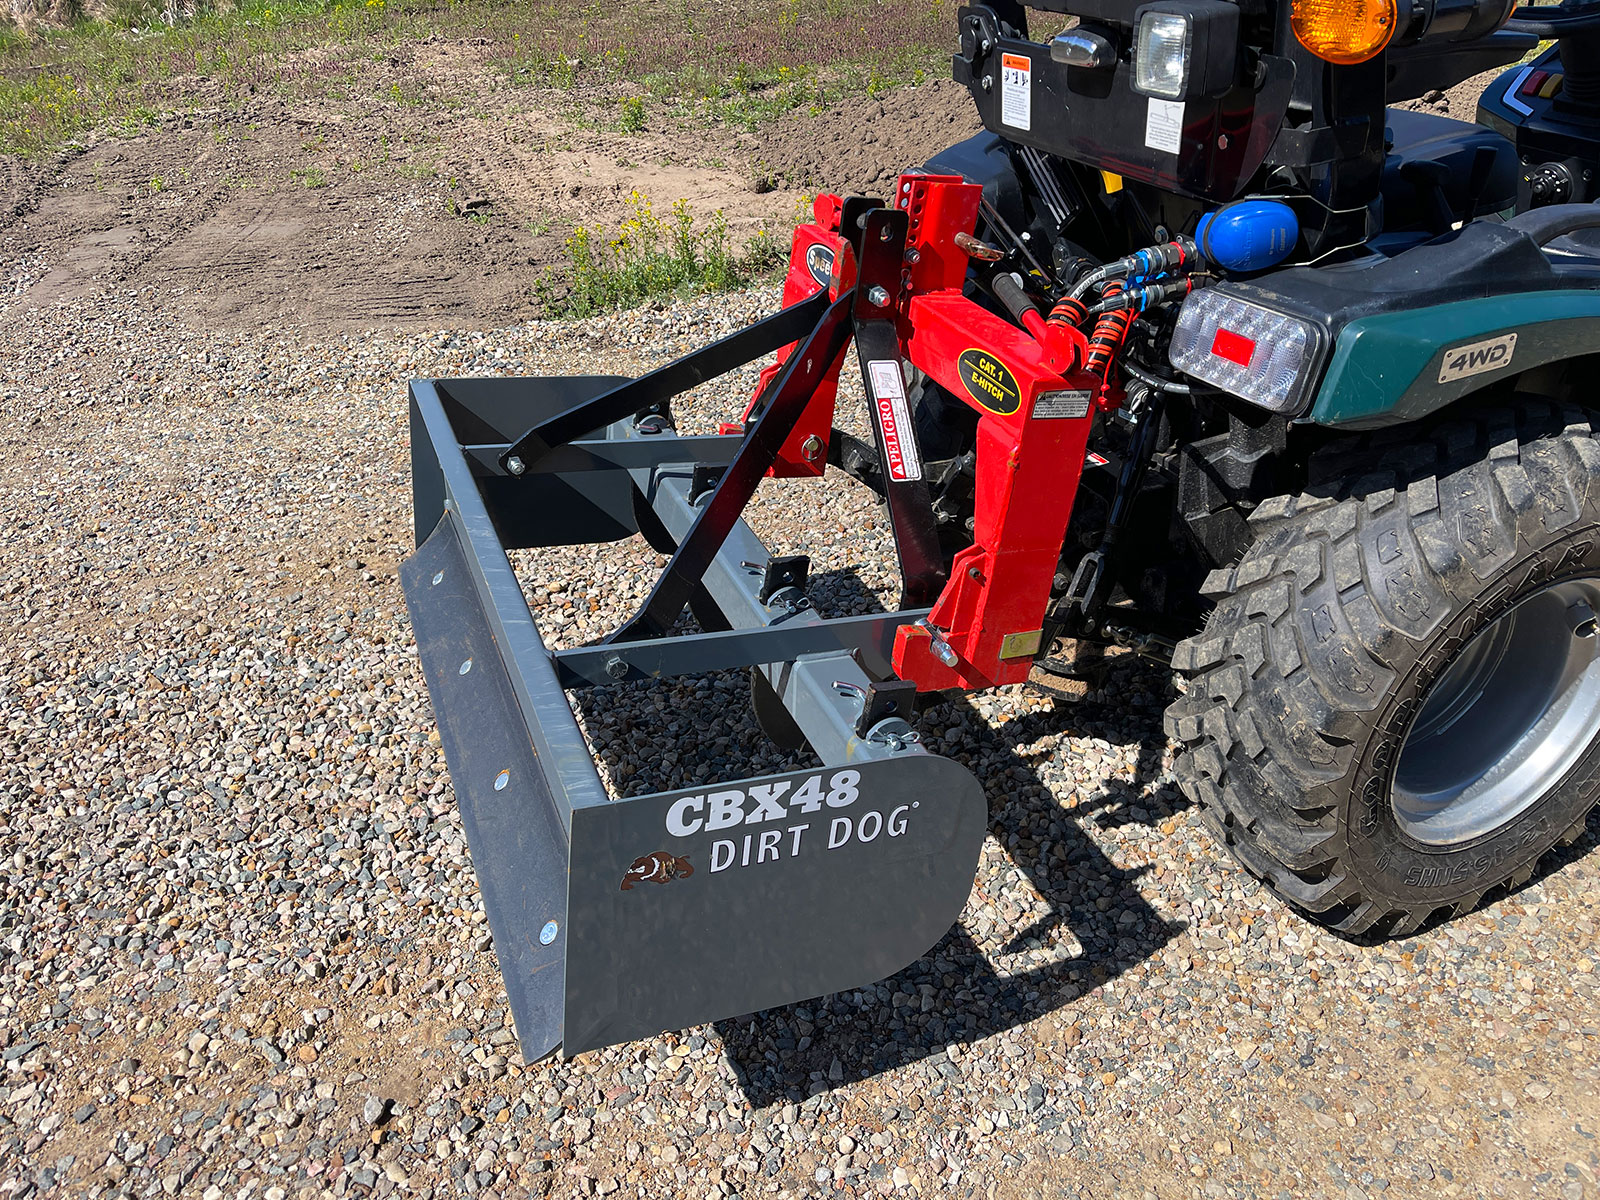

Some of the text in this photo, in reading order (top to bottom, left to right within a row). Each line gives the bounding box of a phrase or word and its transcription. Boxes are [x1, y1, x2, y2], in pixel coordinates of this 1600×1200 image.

[979, 357, 1003, 382] CAT. 1
[1448, 344, 1507, 371] 4WD
[971, 371, 1004, 402] E-HITCH
[880, 400, 901, 463] PELIGRO
[665, 769, 861, 837] CBX48
[709, 823, 810, 874] DIRT
